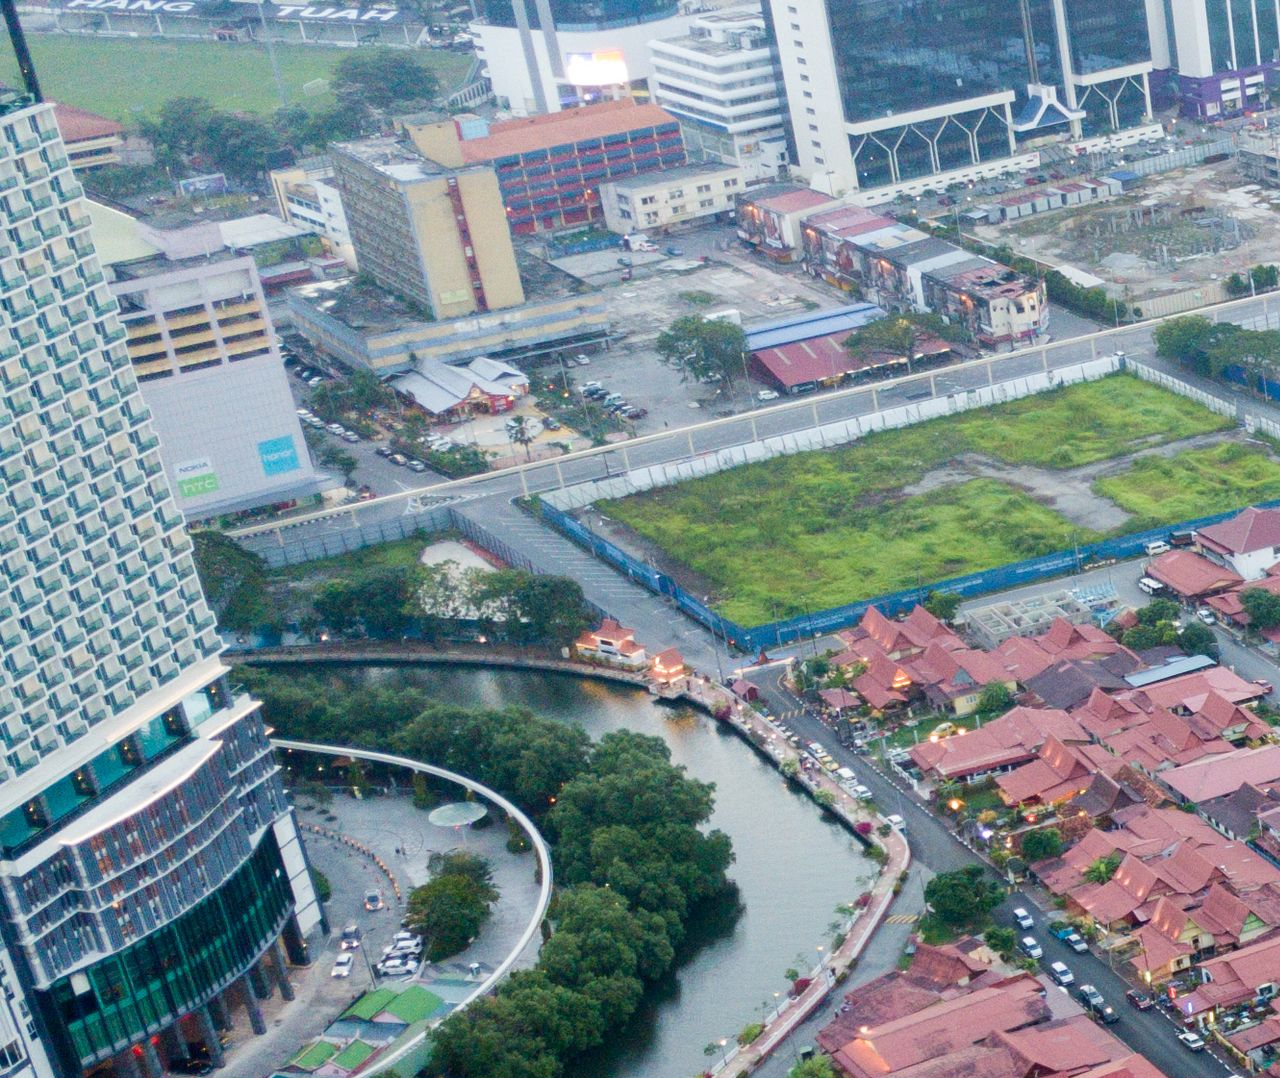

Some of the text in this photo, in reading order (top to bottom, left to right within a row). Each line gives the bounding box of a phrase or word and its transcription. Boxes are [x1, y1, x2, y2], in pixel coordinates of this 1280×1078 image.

[66, 0, 399, 20] HANG TUAH
[178, 461, 209, 473] NOKIA
